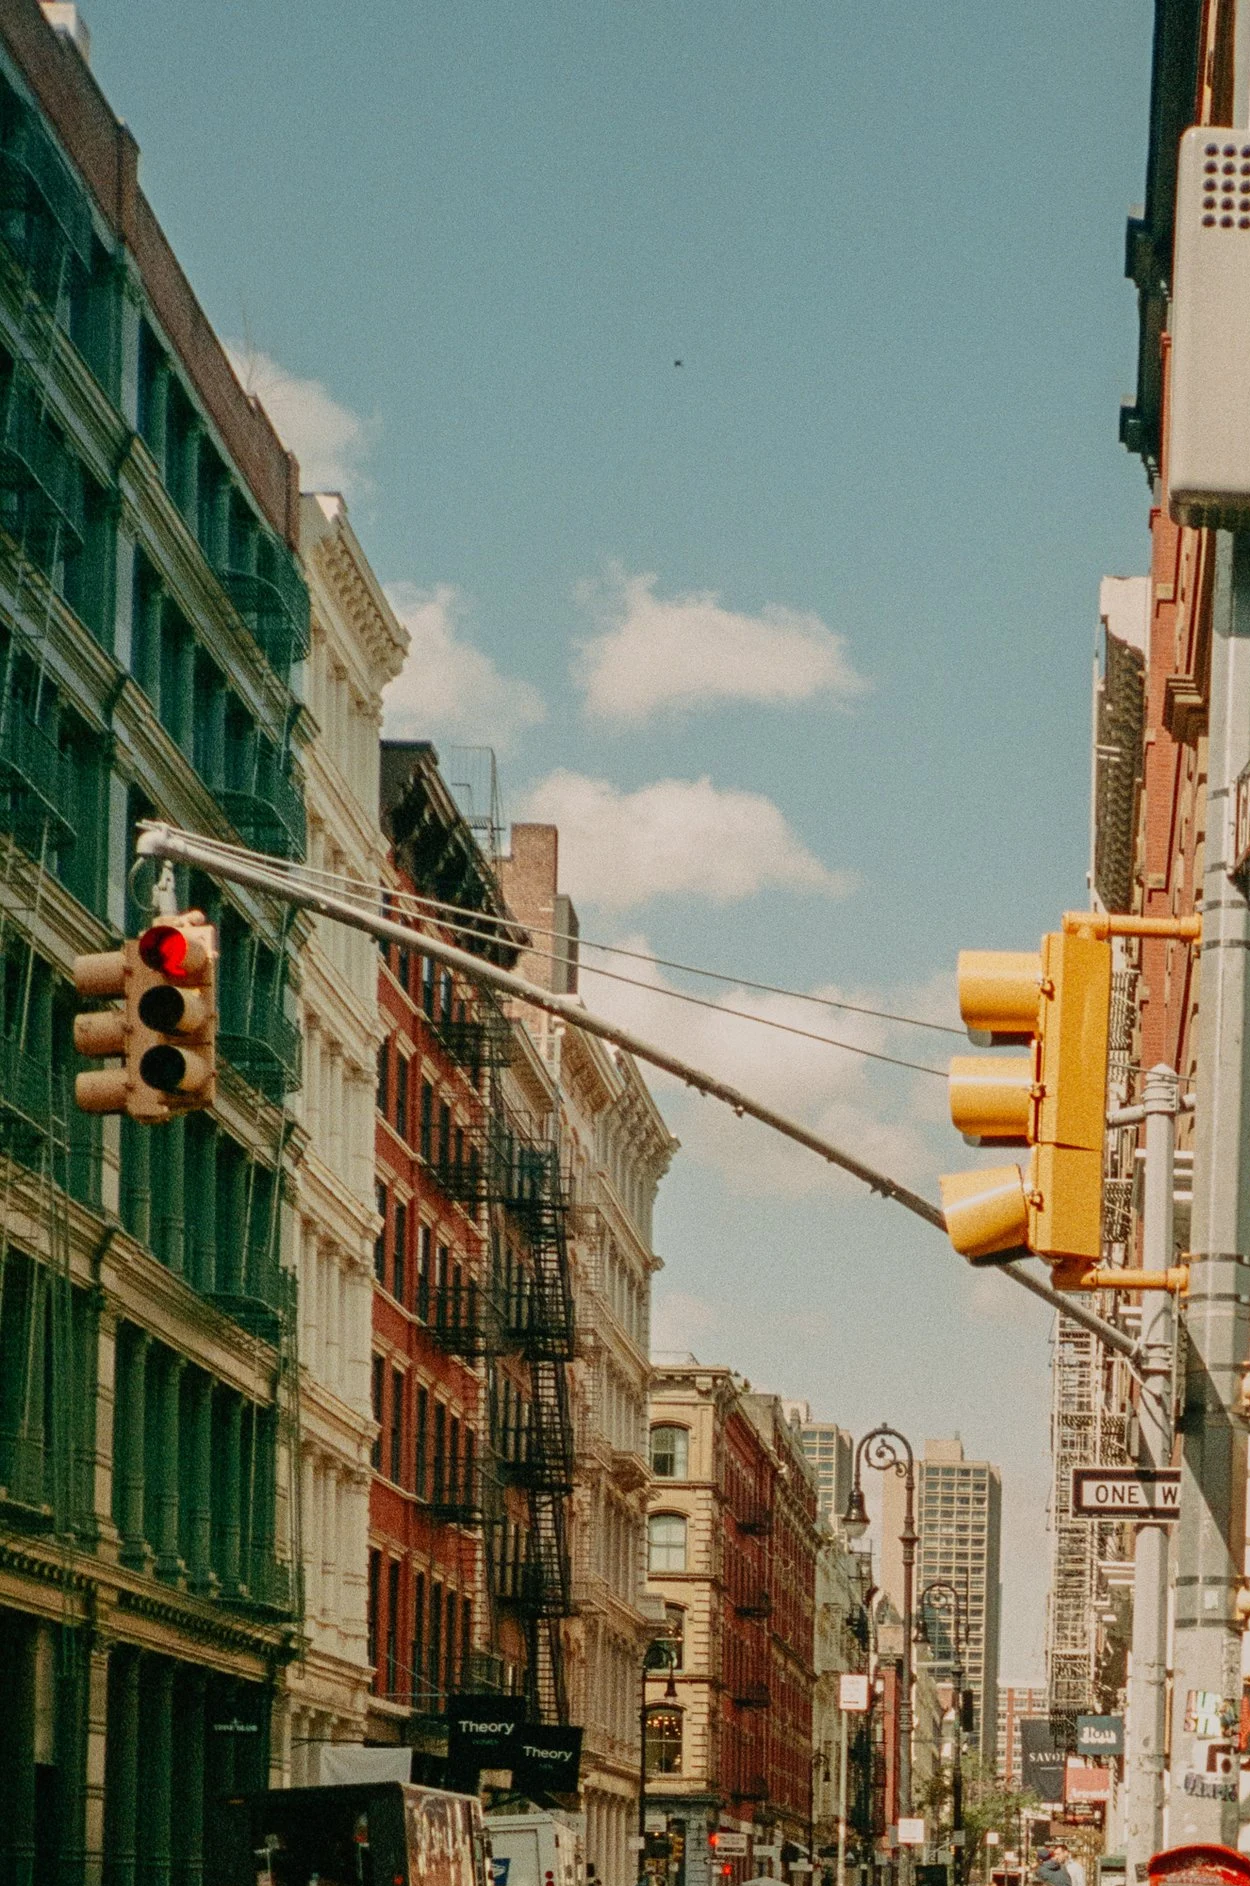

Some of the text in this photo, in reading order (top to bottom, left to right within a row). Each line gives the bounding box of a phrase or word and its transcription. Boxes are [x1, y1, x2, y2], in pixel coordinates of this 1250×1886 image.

[1095, 1484, 1140, 1504] ONE
[458, 1720, 515, 1735] Theory
[523, 1745, 573, 1762] Theory
